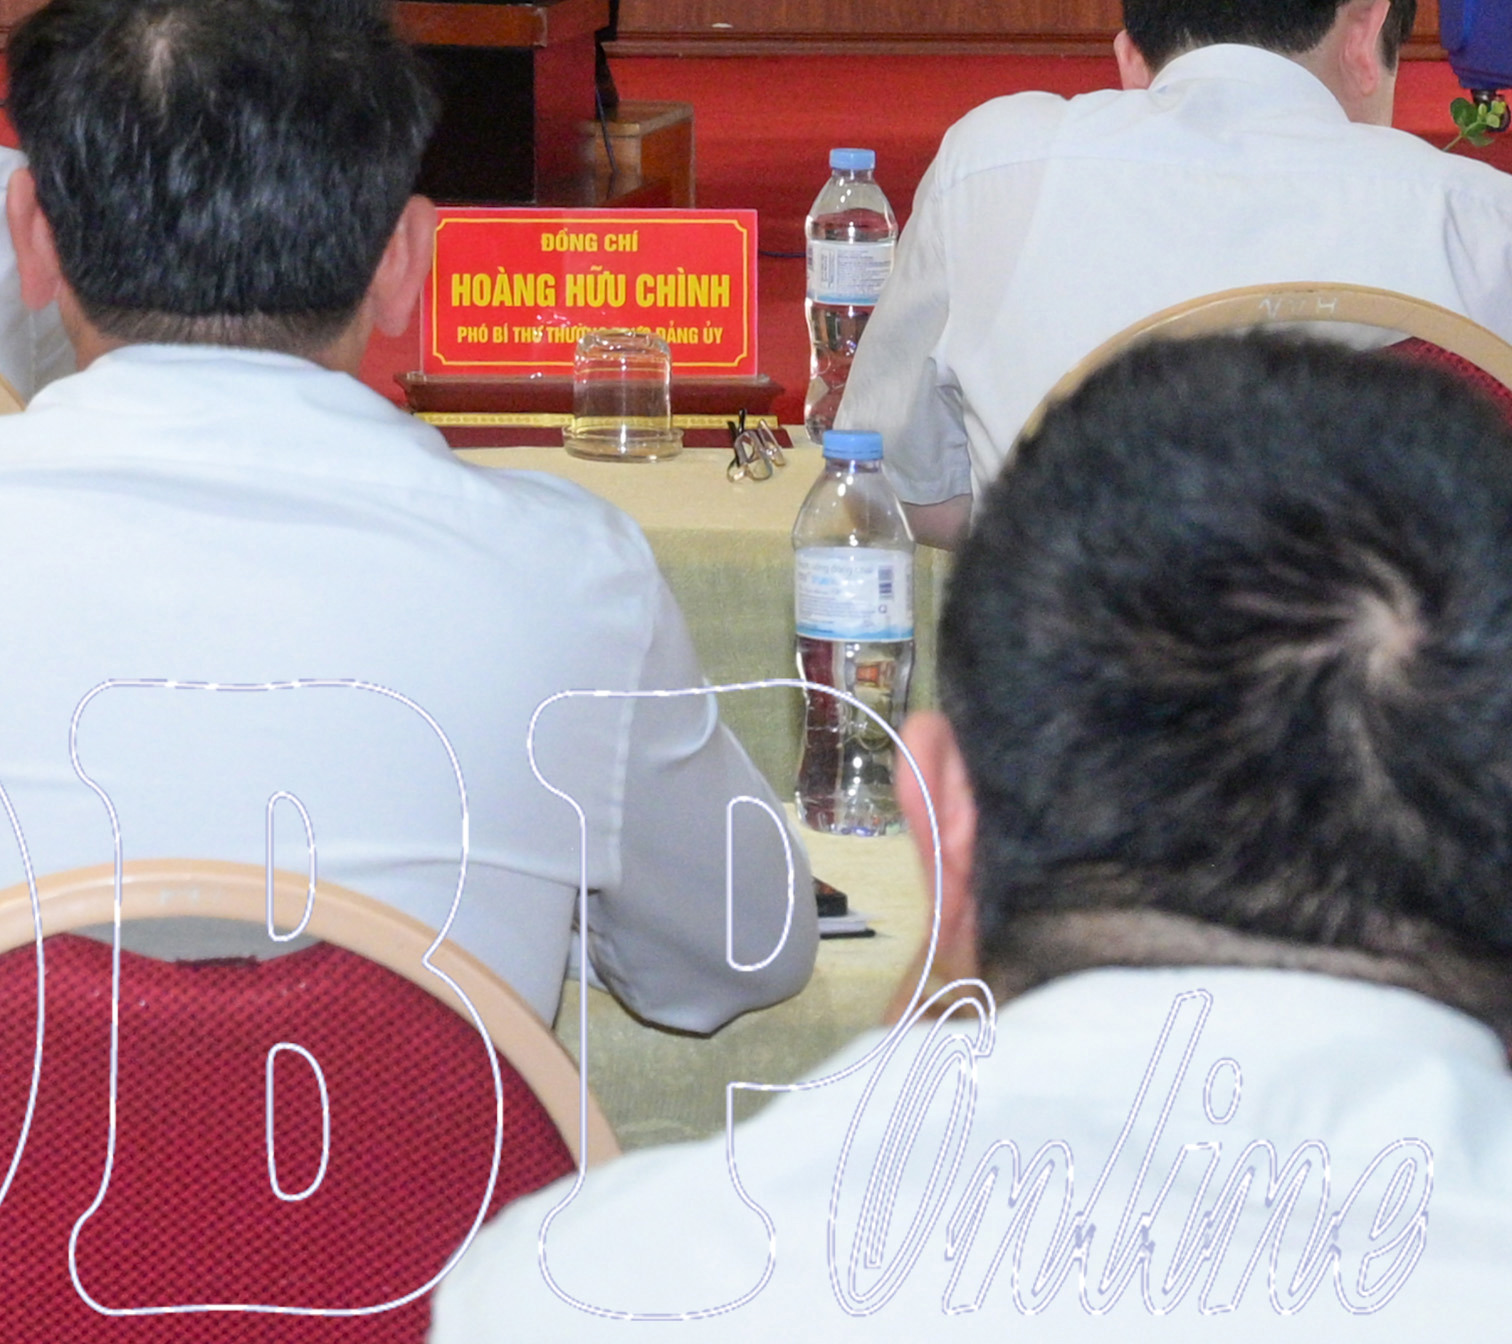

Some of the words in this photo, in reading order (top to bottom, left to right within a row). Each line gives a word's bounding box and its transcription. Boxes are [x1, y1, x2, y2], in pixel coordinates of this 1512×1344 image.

[540, 228, 599, 252] ĐỒNG
[604, 230, 639, 252] CHÍ
[450, 266, 556, 308] HOÀNG
[565, 264, 627, 308] HỮU
[635, 266, 731, 308] CHÌNH
[457, 323, 488, 344] PHÓ
[492, 323, 509, 344] BÍ
[513, 324, 545, 344] THƯ
[702, 320, 724, 344] ỦY
